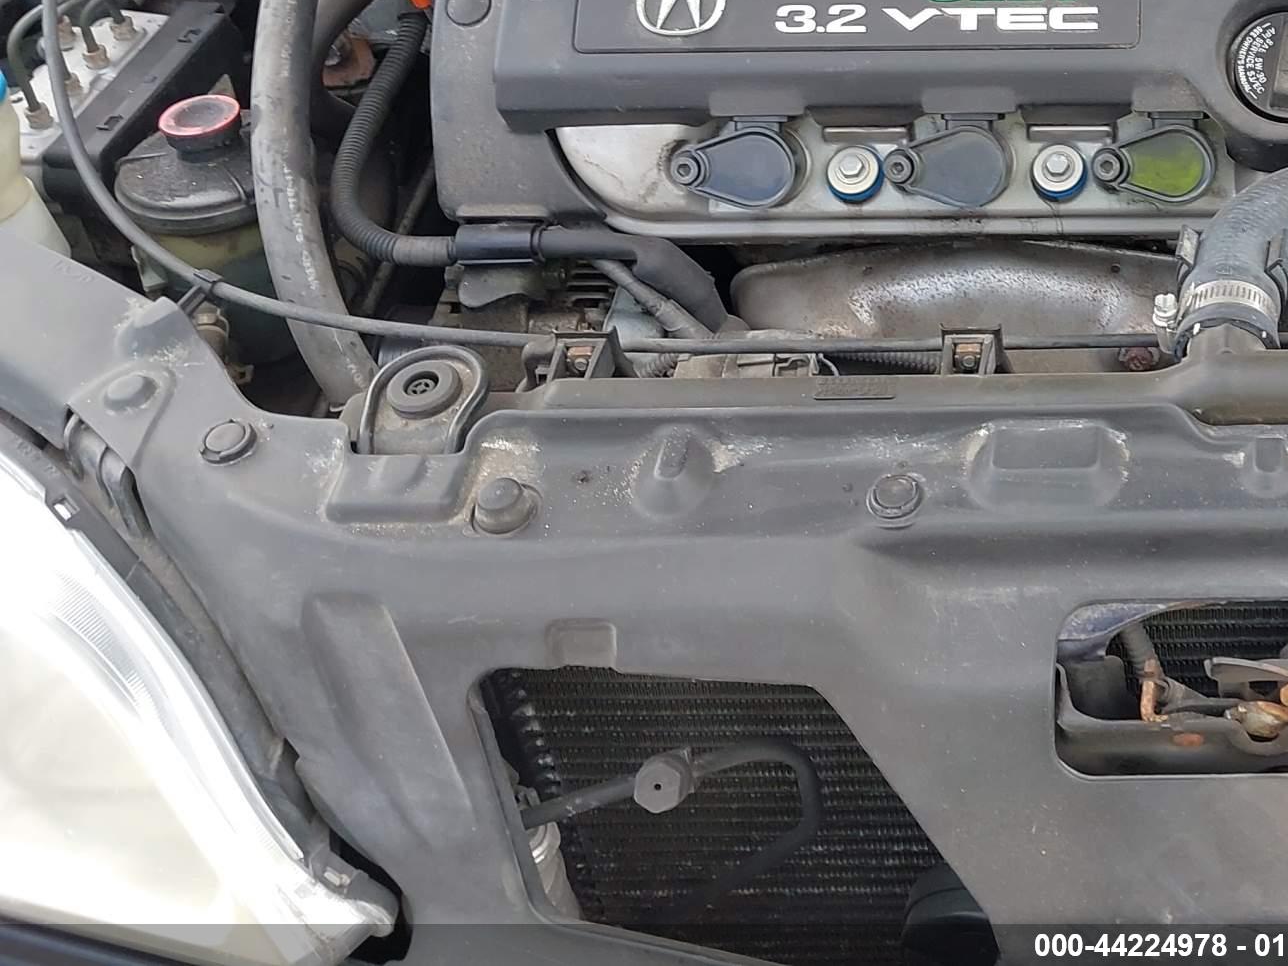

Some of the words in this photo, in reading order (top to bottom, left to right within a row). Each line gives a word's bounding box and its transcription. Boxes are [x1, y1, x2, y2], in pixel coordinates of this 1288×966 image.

[774, 3, 867, 33] 3.2
[881, 6, 1099, 32] VTEC
[1258, 38, 1274, 53] SAE
[1262, 27, 1276, 39] API
[1246, 37, 1264, 68] SERVICE
[1237, 65, 1252, 93] MANUAL
[1254, 57, 1268, 83] 5W-30
